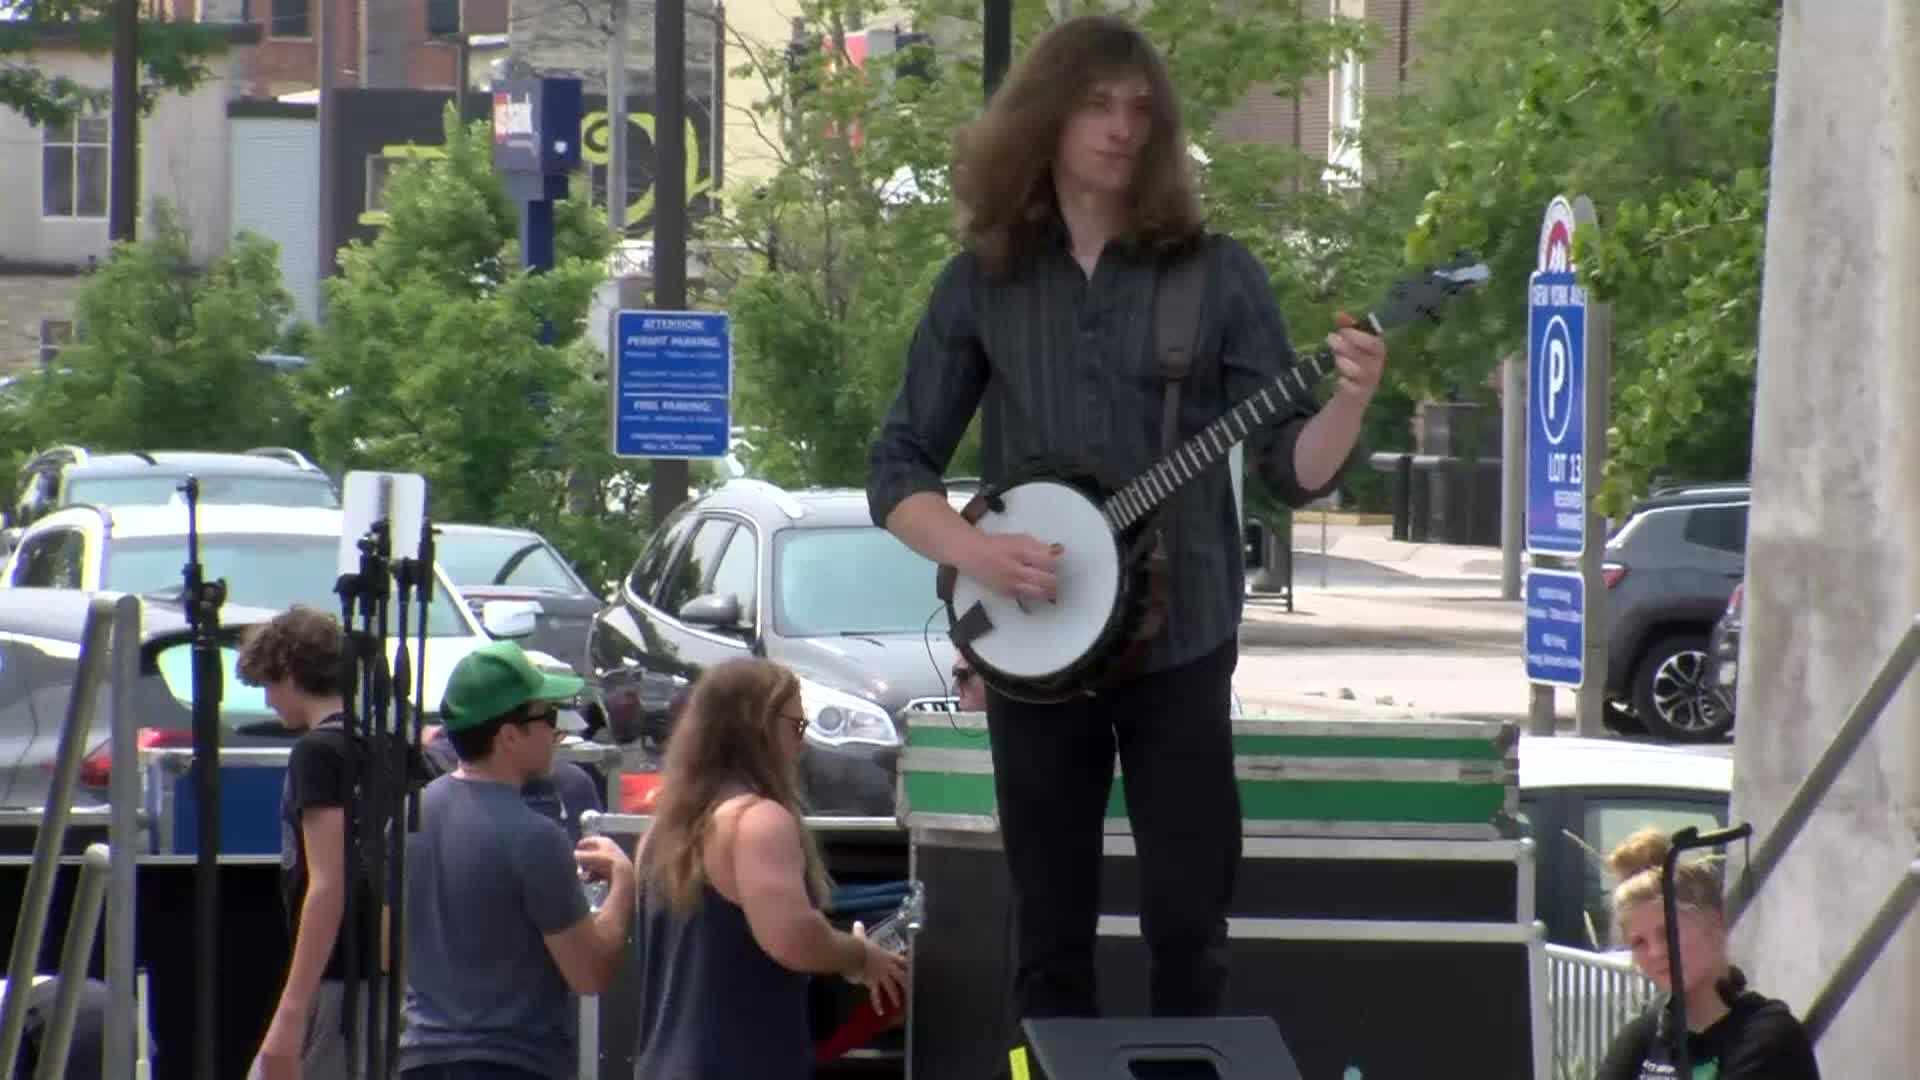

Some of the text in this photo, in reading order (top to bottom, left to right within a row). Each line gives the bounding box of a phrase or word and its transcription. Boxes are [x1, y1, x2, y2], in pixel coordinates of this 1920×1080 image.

[1548, 338, 1565, 420] P
[1548, 453, 1582, 484] LOT 13
